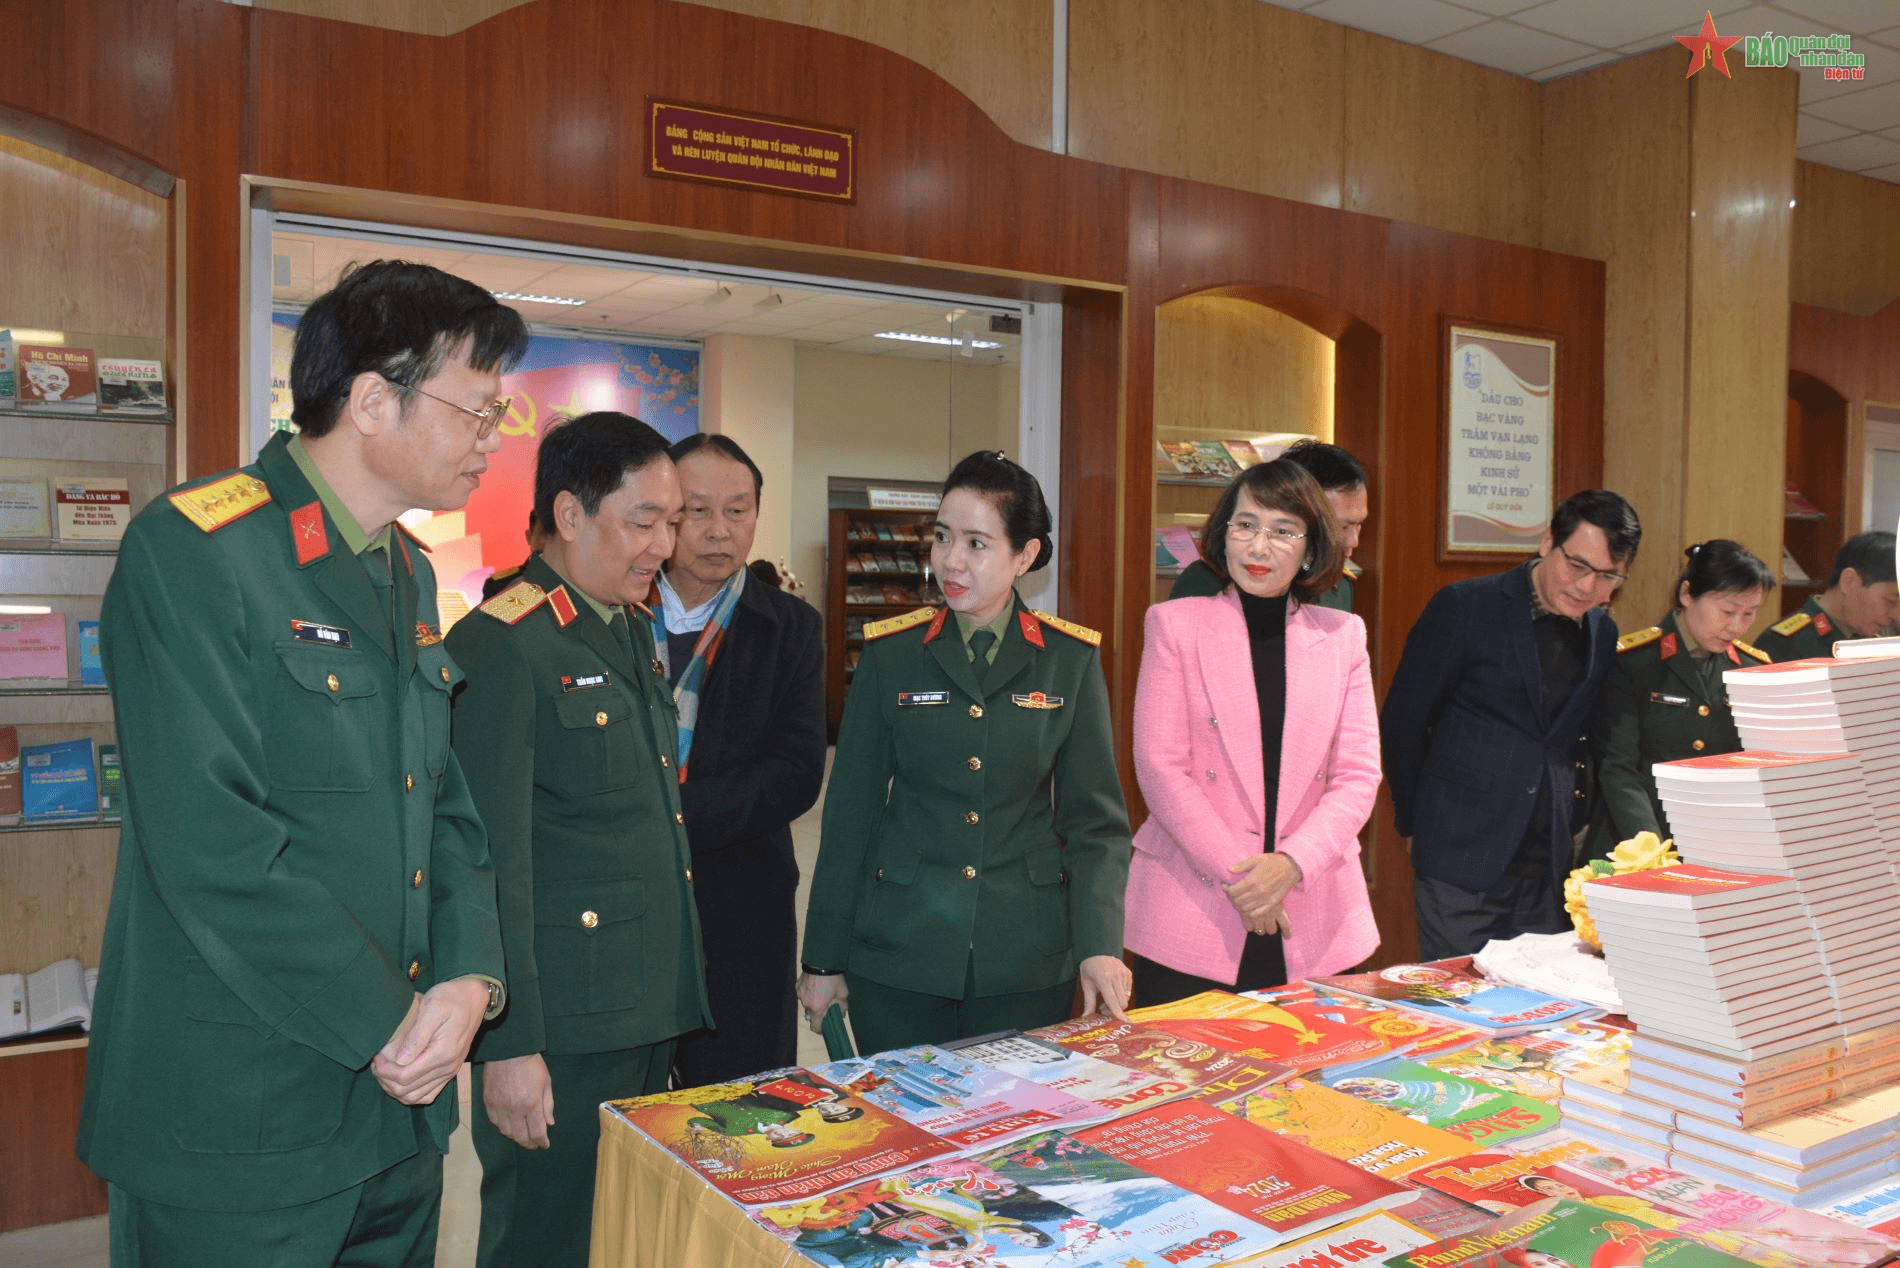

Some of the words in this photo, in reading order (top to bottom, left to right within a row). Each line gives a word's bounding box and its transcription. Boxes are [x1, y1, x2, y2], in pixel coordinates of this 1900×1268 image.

[666, 124, 688, 139] ĐẢNG
[693, 129, 714, 143] CỘNG
[716, 131, 732, 146] SẢN
[734, 134, 749, 149] VIỆT
[751, 138, 769, 151] NAM
[672, 143, 683, 156] VÀ
[702, 149, 726, 163] LUYỆN
[727, 152, 748, 166] QUÂN
[750, 155, 762, 169] ĐỘI
[764, 158, 785, 171] NHÂN
[803, 163, 818, 176] VIỆT
[820, 166, 836, 178] NAM
[64, 353, 88, 363] Minh
[1503, 393, 1524, 406] CHO
[1480, 467, 1506, 479] KINH
[1363, 1162, 1392, 1173] vọ
[779, 1175, 831, 1198] nhân
